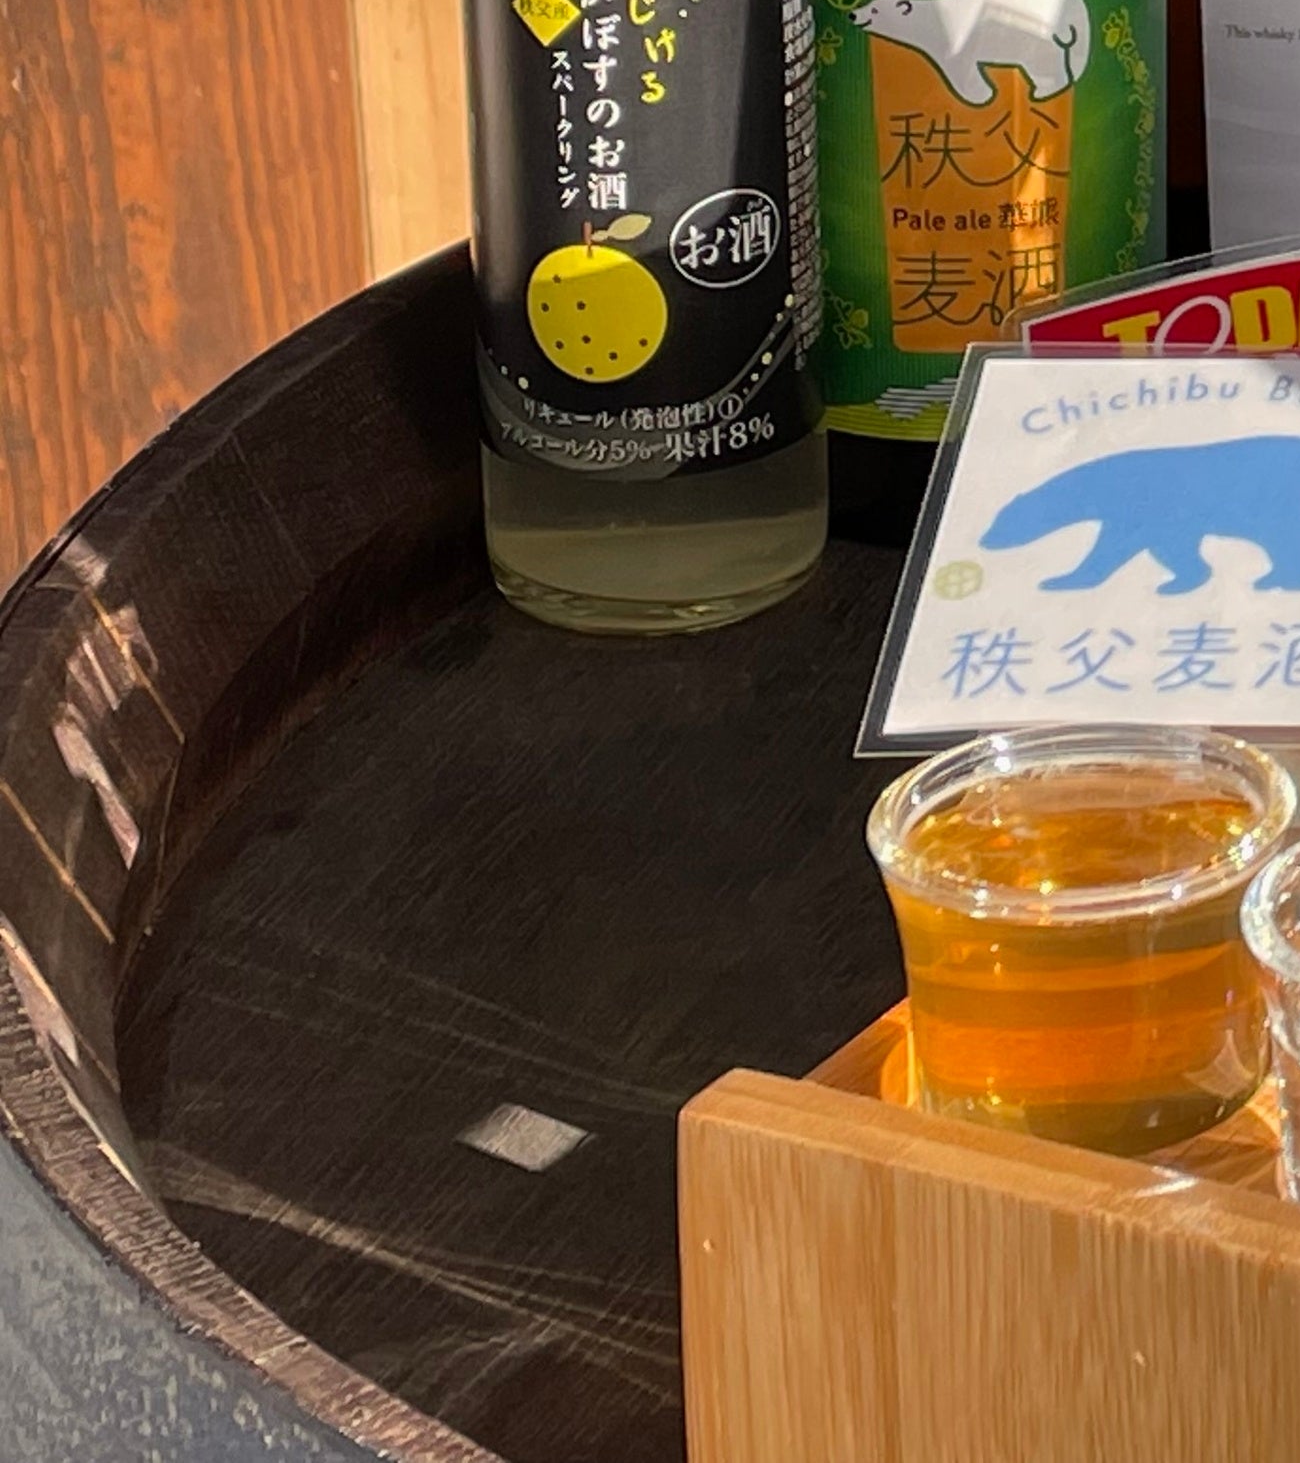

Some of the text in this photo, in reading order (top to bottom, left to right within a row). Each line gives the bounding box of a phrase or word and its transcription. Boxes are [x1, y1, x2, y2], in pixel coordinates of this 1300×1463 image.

[551, 50, 581, 209] スパークリング
[881, 107, 1072, 189] 秩父
[679, 200, 773, 269] お酒
[893, 207, 947, 231] Pale
[954, 209, 992, 231] ale
[1021, 376, 1241, 435] Chichibu
